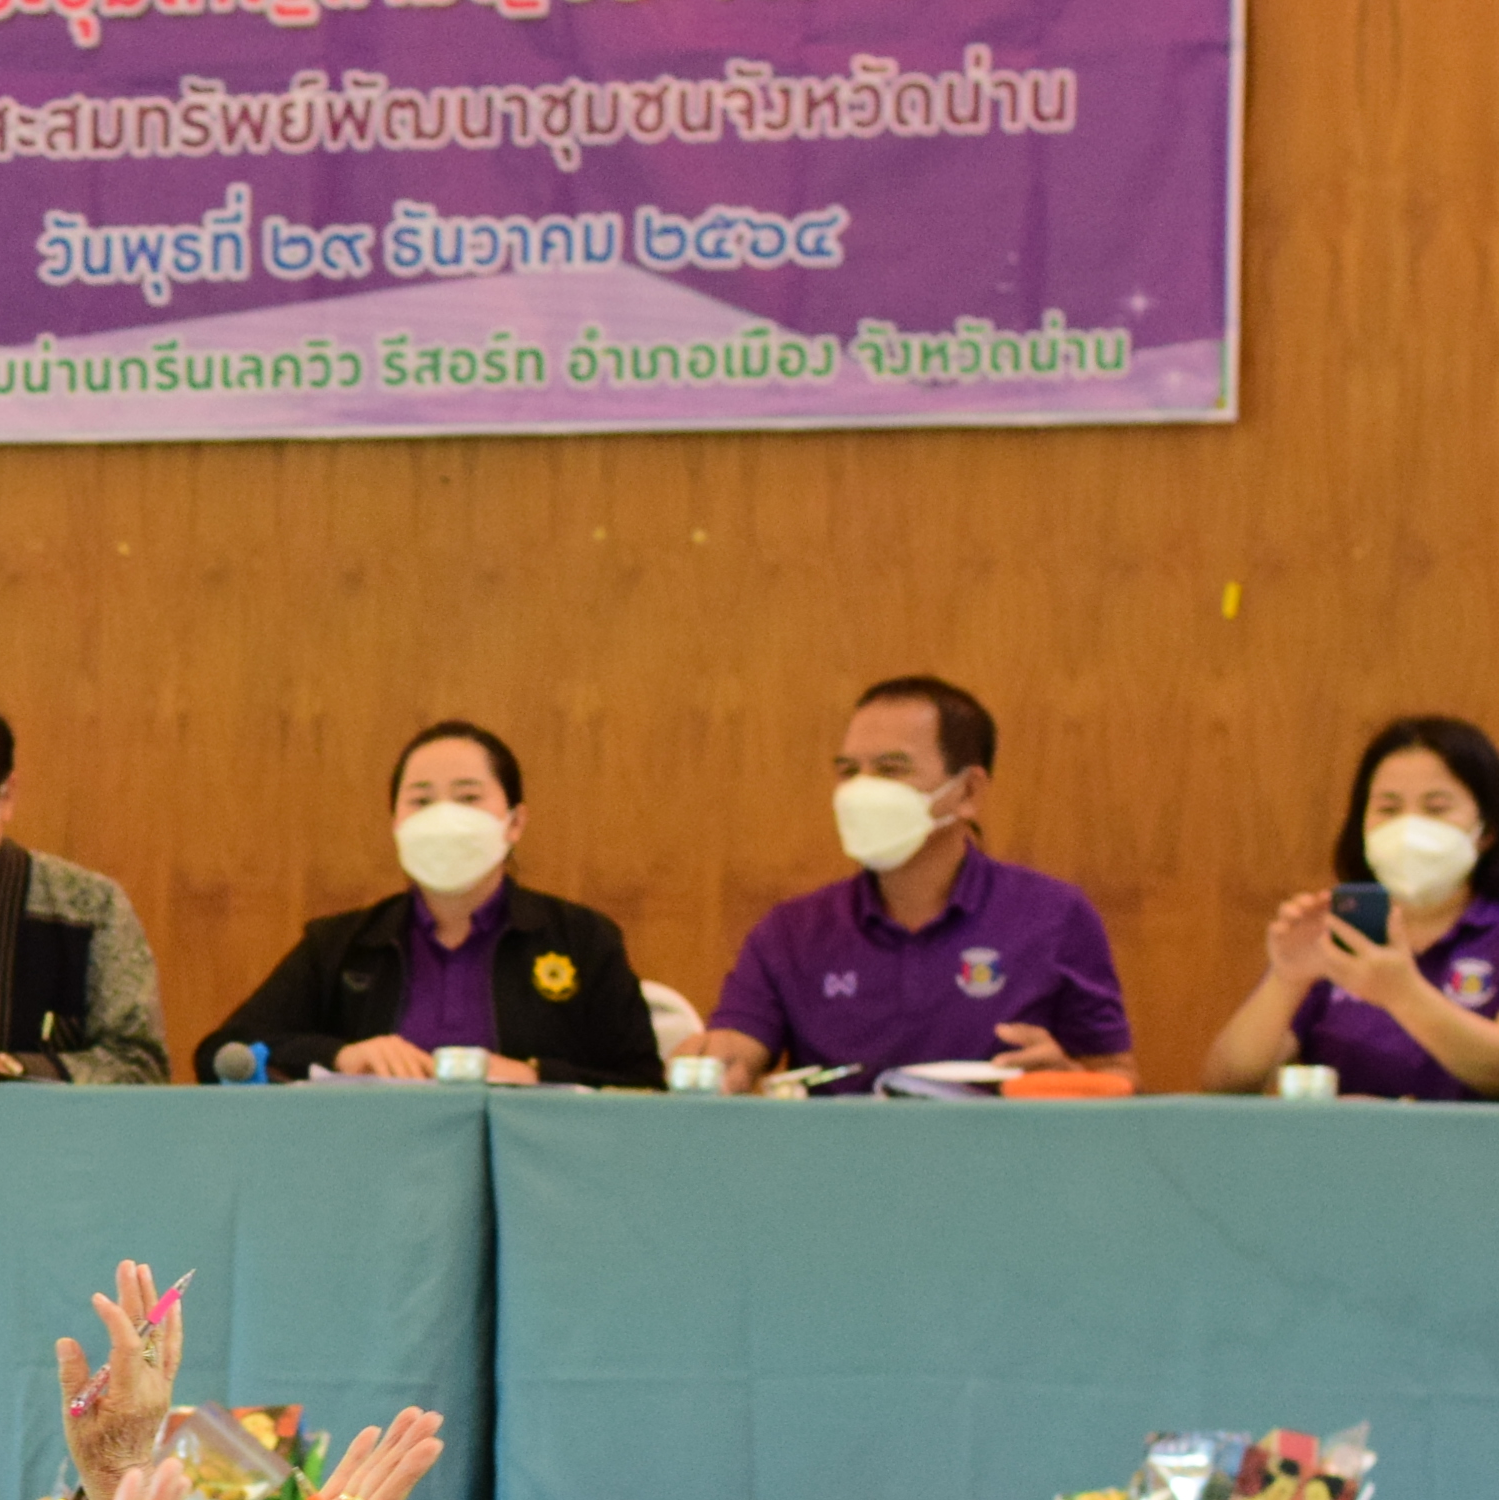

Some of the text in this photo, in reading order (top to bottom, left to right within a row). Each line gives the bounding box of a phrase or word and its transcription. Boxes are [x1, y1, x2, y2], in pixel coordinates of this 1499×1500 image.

[41, 186, 249, 303] วันพุธที่
[266, 217, 371, 275] ๒๙
[389, 202, 620, 275] ธันวาคม
[383, 330, 545, 387] รีสอร์ท
[568, 325, 836, 382] อำเภอเมือง
[857, 312, 1125, 377] จังหวัดน่าน
